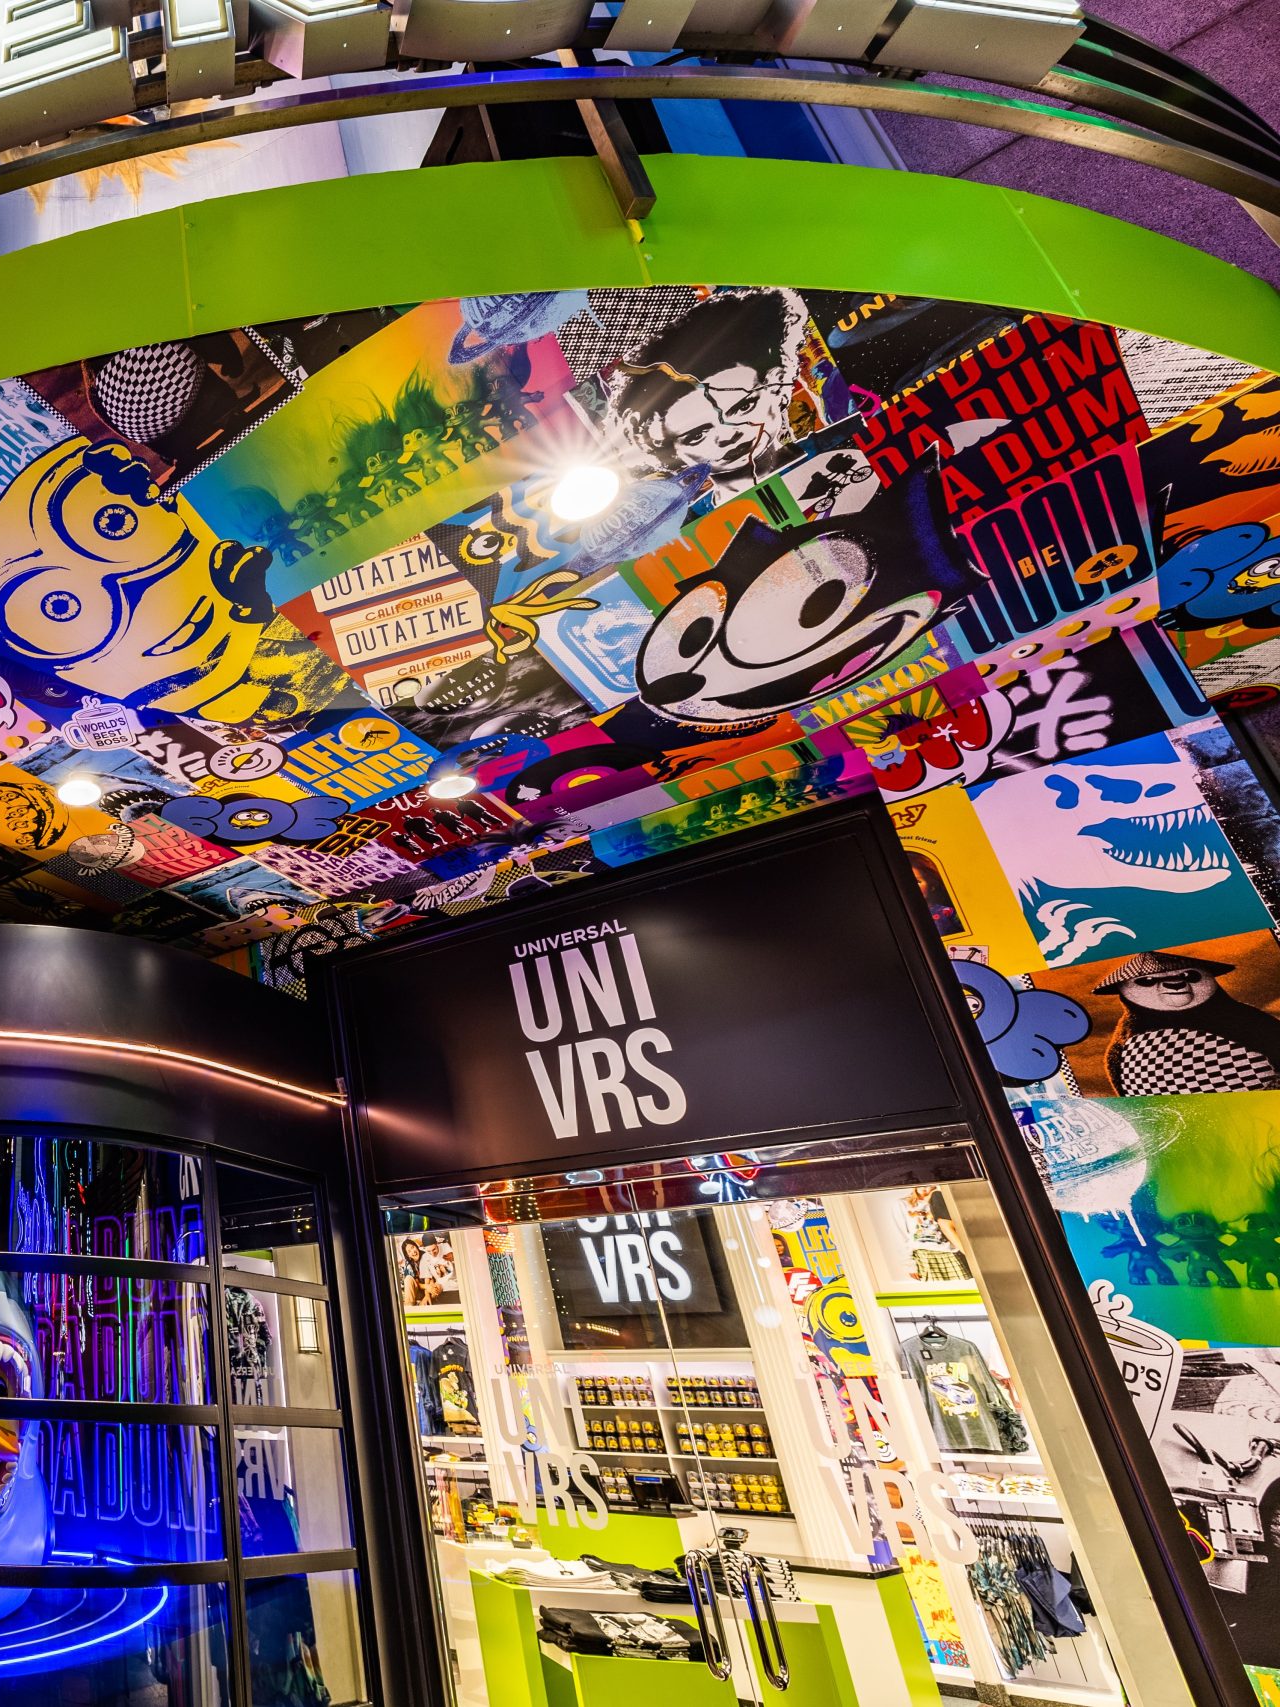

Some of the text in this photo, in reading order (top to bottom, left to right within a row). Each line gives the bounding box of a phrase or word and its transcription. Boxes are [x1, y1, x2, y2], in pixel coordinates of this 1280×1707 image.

[980, 375, 1141, 485] DUM
[321, 545, 452, 601] OUTATIME
[1017, 544, 1061, 578] BE
[365, 592, 443, 622] CALIFORNIA
[346, 601, 472, 655] OUTATIME
[397, 650, 471, 677] CALIFORNIA
[426, 669, 497, 708] UNIVERSAL
[444, 681, 497, 711] PICTURE
[811, 654, 949, 727] MINION
[81, 716, 126, 734] WORLD'S
[92, 727, 123, 741] BEST
[96, 734, 128, 747] BOSS
[283, 733, 366, 783] LIFE
[388, 755, 434, 784] A WAY
[330, 856, 367, 877] DON'T
[339, 865, 382, 883] CARE
[412, 874, 474, 911] UNIVERSAL
[514, 919, 627, 958] UNIVERSAL
[508, 933, 657, 1043] UNI
[525, 1027, 687, 1139] VRS
[580, 1231, 693, 1303] VRS
[495, 1363, 570, 1375] UNIVERSAL
[491, 1377, 591, 1449] UNI
[504, 1451, 609, 1531] VRS
[819, 1463, 980, 1566] VRS
